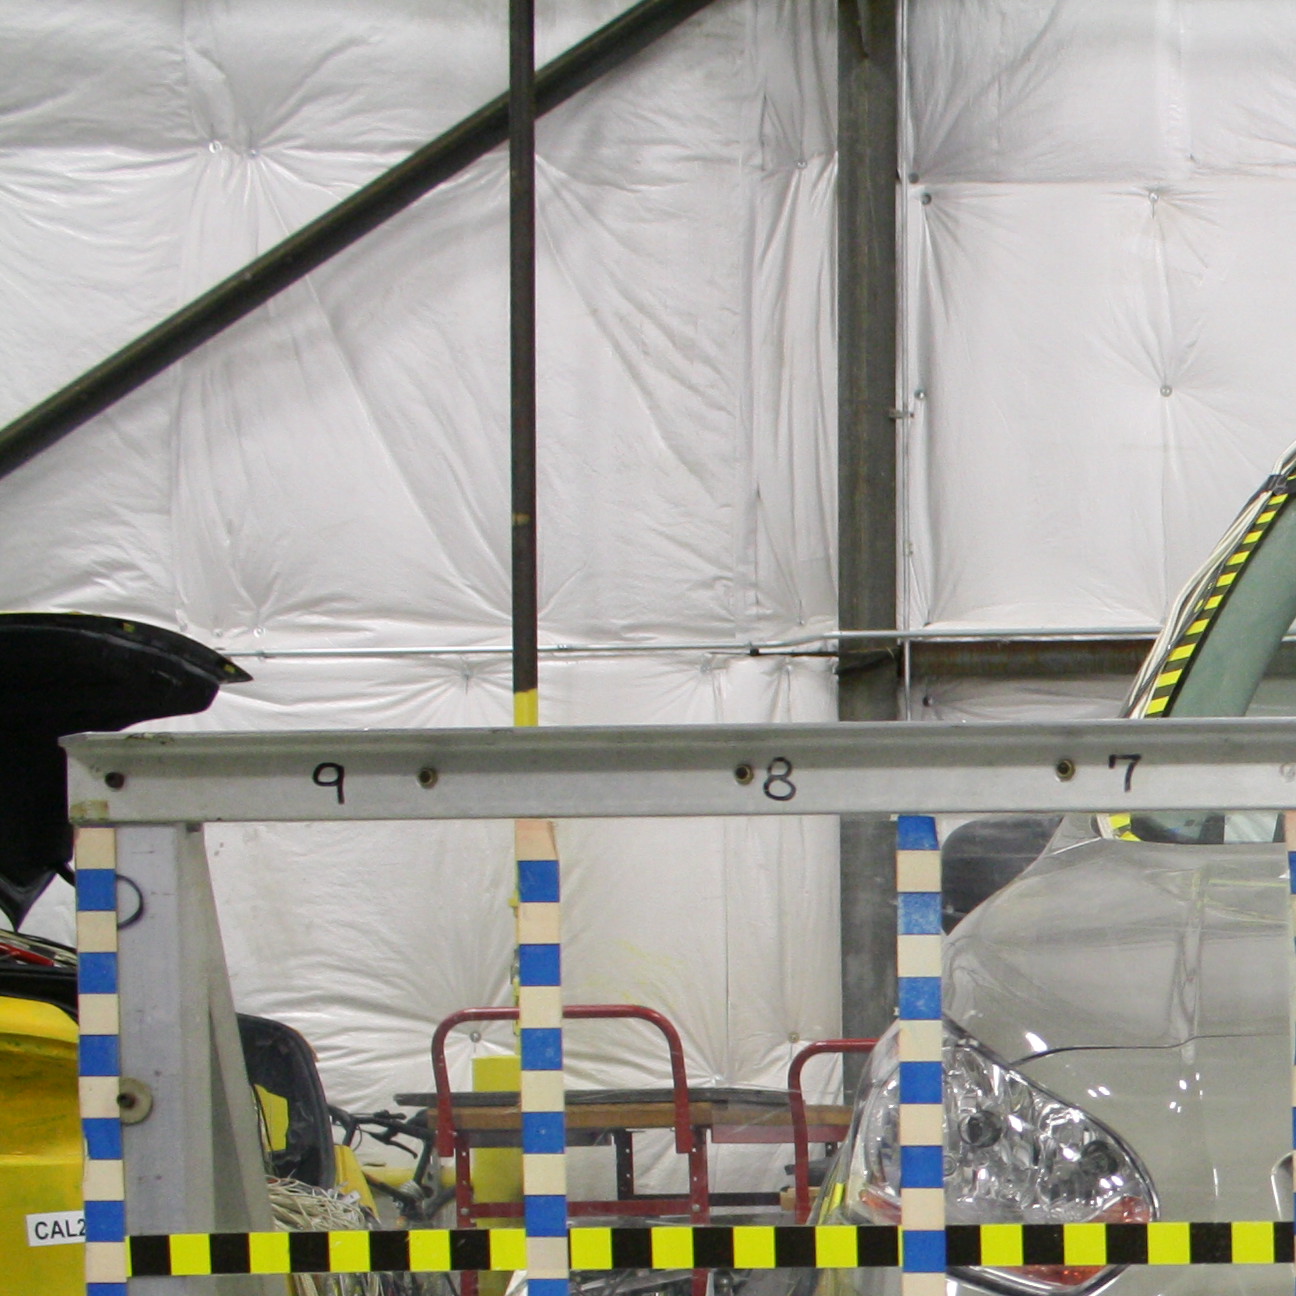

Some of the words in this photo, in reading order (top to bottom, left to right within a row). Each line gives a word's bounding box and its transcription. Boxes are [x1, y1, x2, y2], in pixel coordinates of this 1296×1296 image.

[312, 762, 345, 805] 9
[763, 757, 796, 802] 8
[1108, 754, 1141, 793] 7
